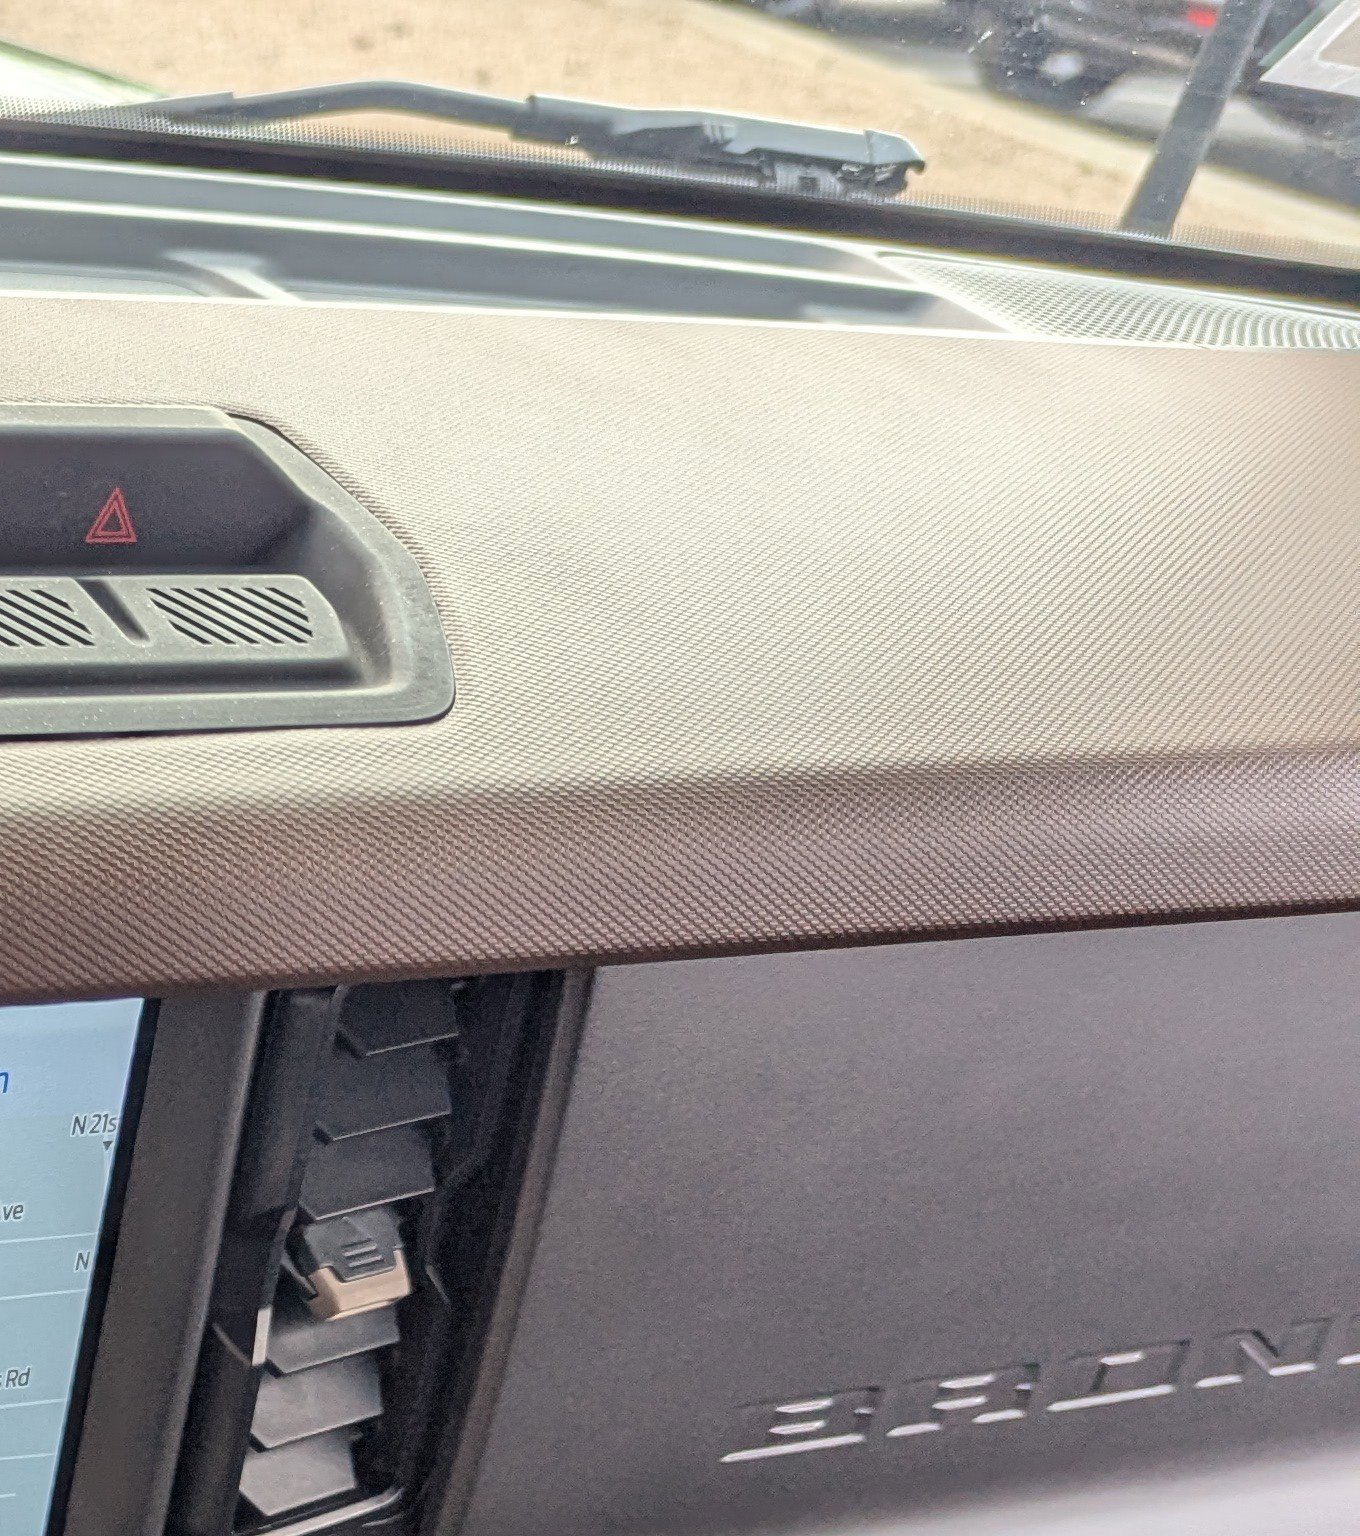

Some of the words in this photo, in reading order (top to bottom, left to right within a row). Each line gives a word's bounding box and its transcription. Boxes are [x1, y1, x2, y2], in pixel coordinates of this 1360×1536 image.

[71, 1115, 87, 1136] N
[75, 1251, 91, 1272] N
[5, 1367, 31, 1389] Rd
[720, 1312, 1360, 1464] BRON
